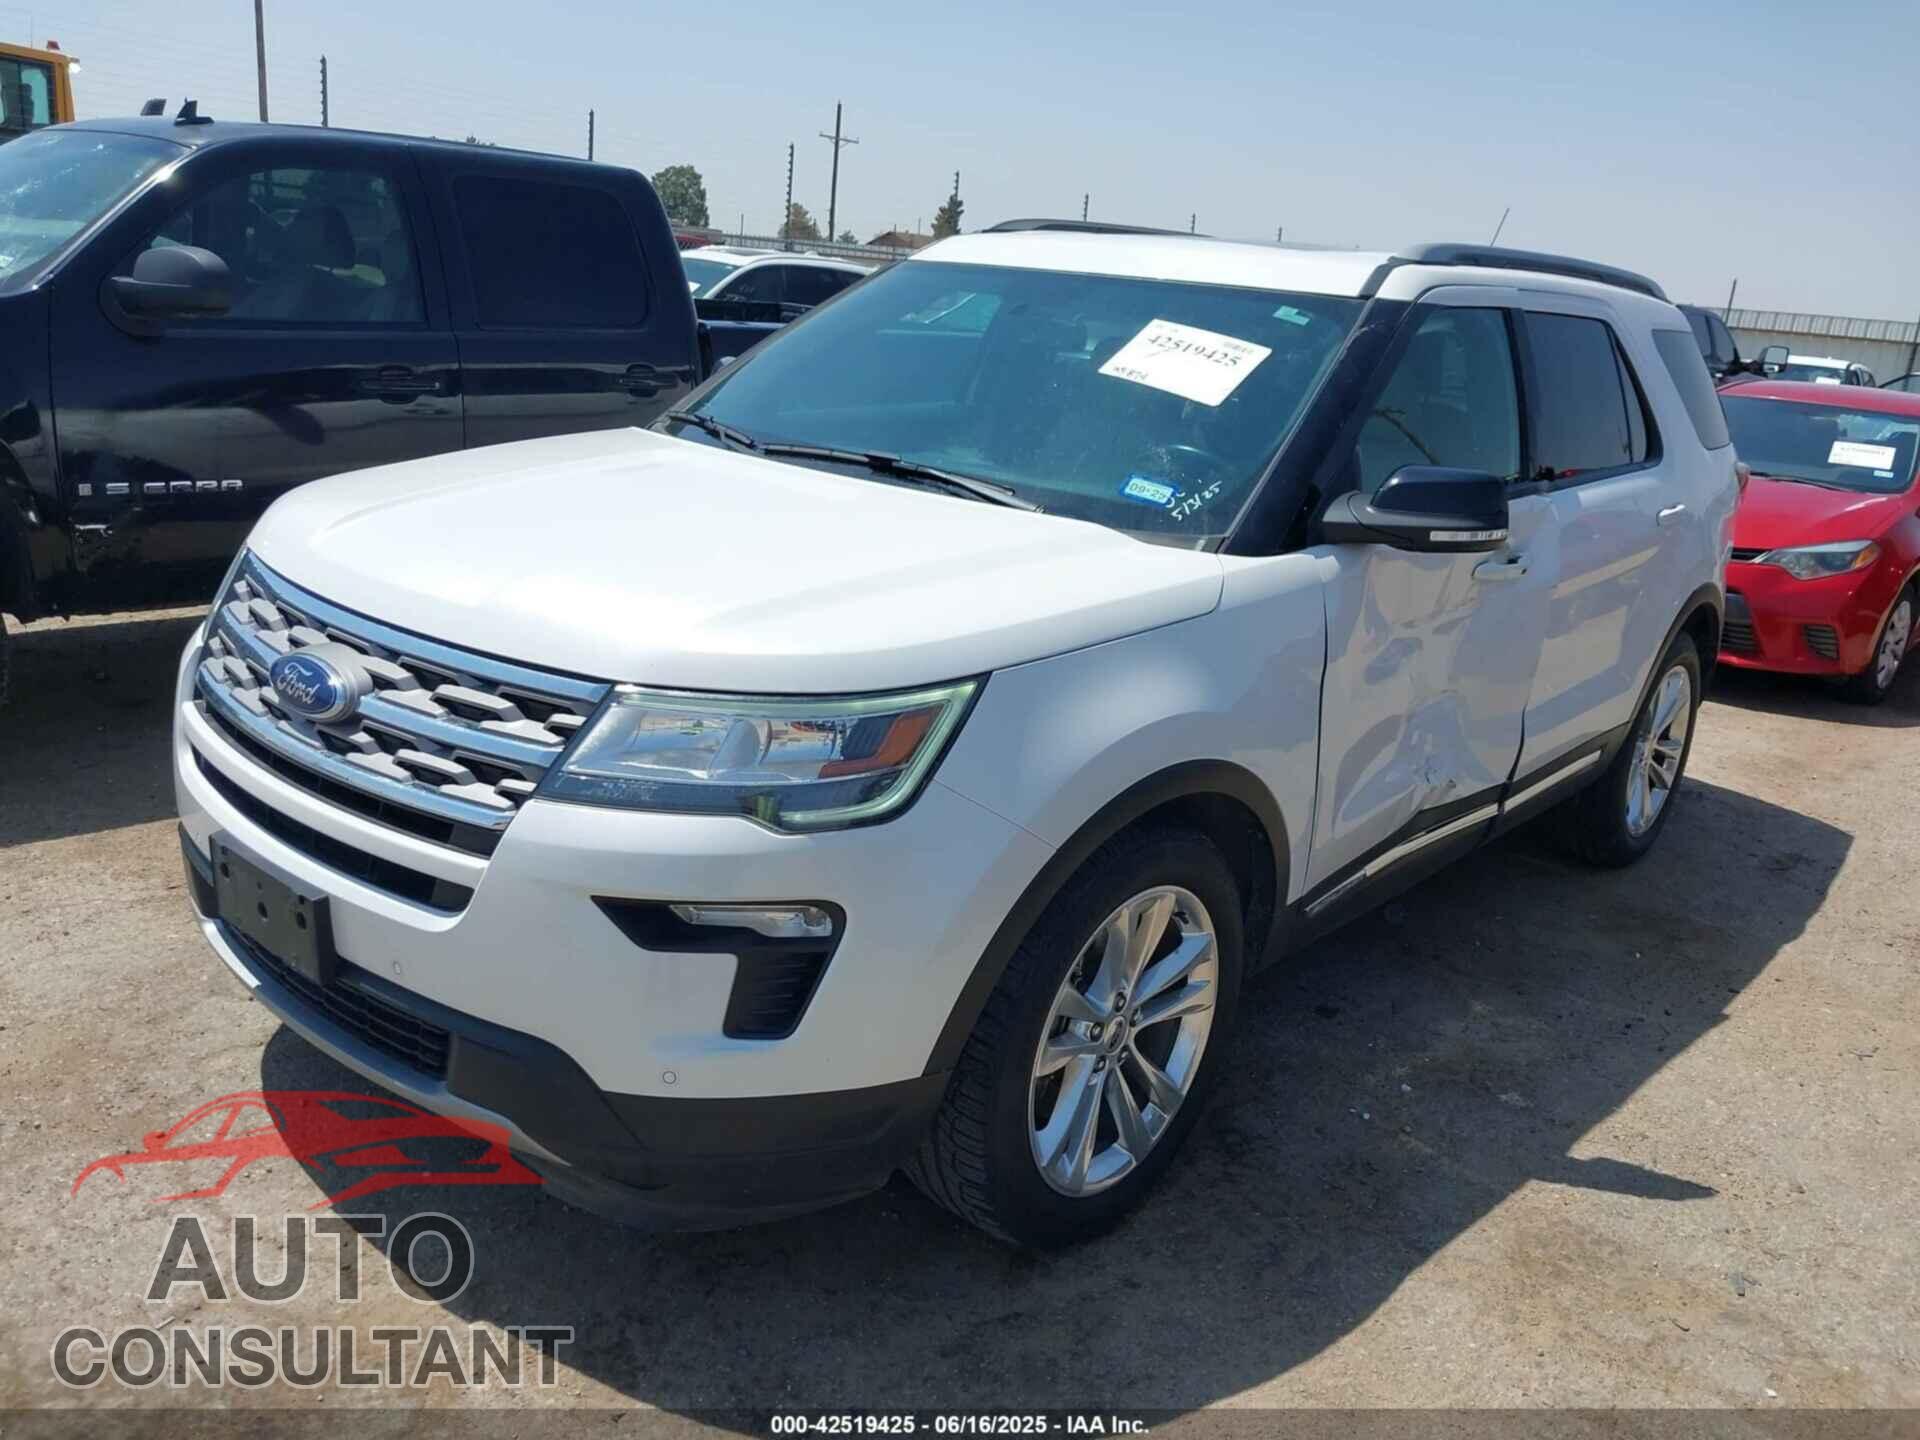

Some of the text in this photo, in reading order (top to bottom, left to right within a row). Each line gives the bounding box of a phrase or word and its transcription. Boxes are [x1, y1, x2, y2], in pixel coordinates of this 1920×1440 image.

[1147, 335, 1242, 366] 42519425
[105, 479, 243, 495] SERRA
[276, 662, 320, 704] Ford
